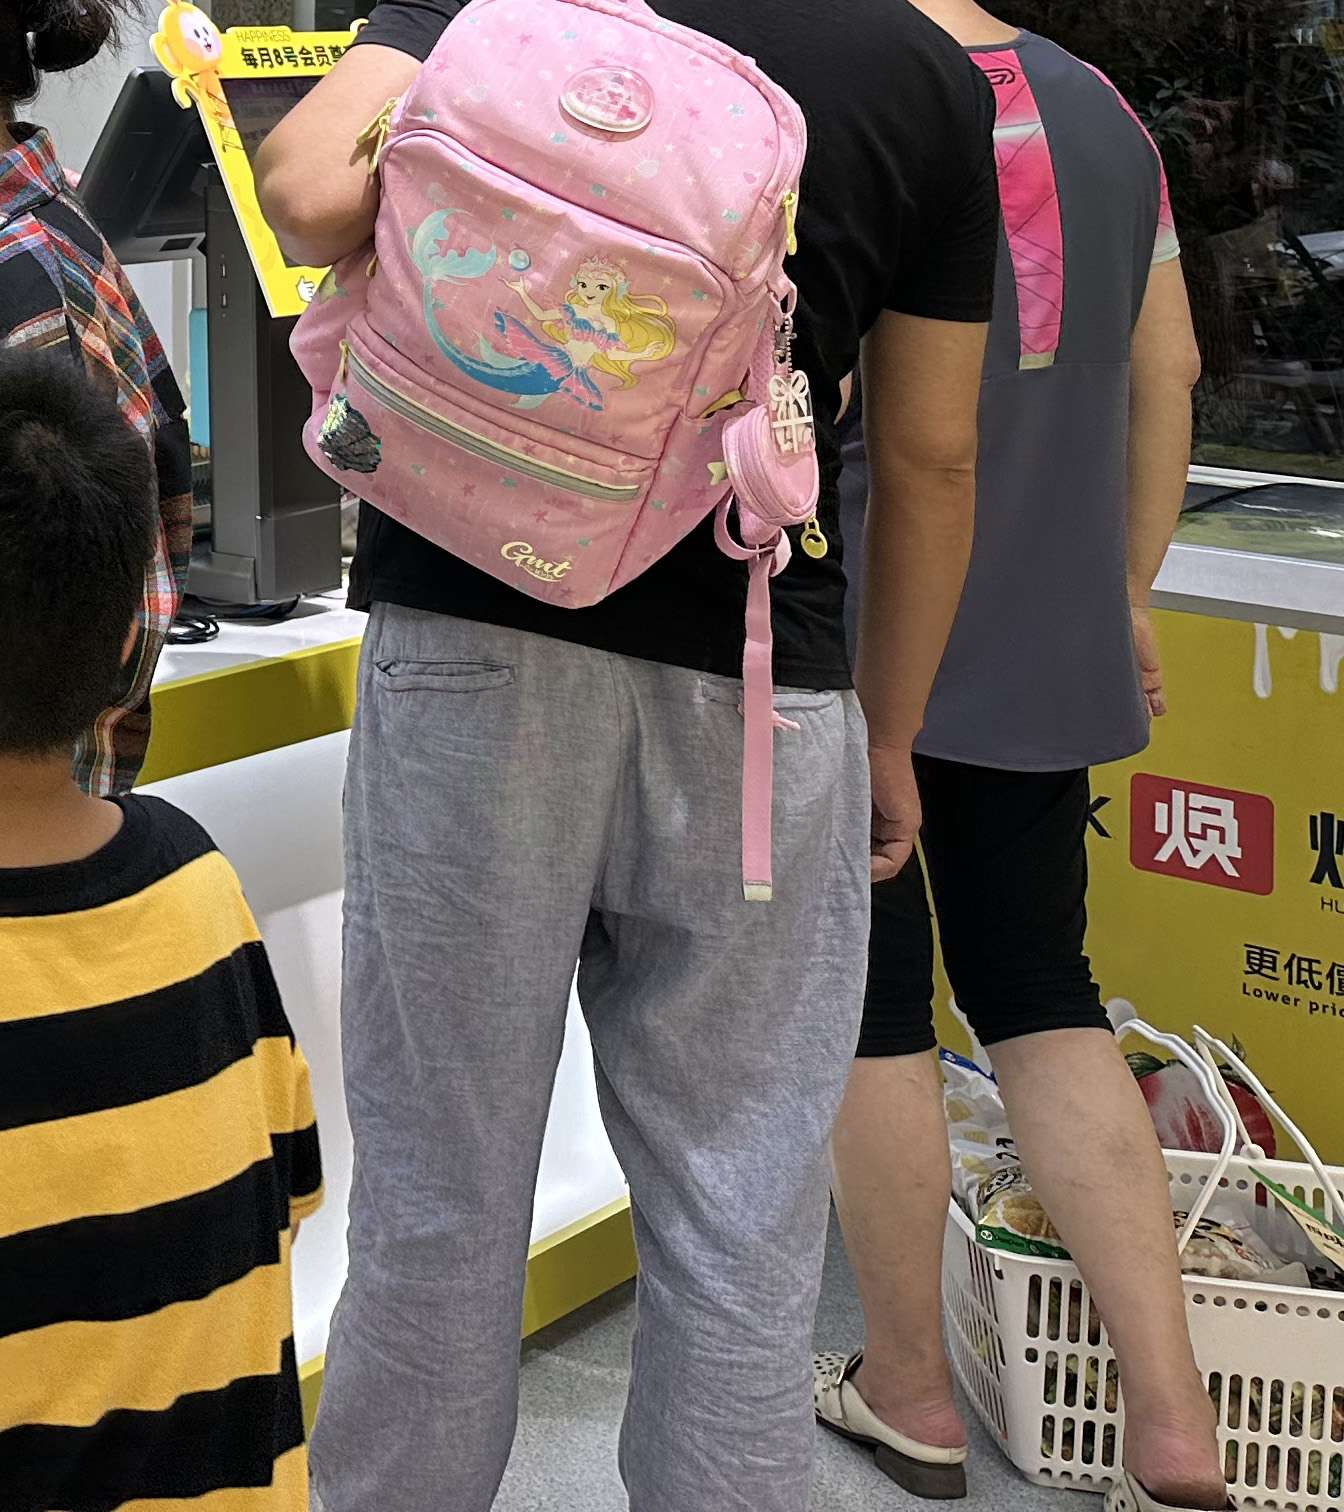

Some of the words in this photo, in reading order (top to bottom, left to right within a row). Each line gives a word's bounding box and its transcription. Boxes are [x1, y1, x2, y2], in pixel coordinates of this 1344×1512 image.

[240, 44, 352, 69] 每月8号会员尊
[1242, 981, 1301, 1008] Lower
